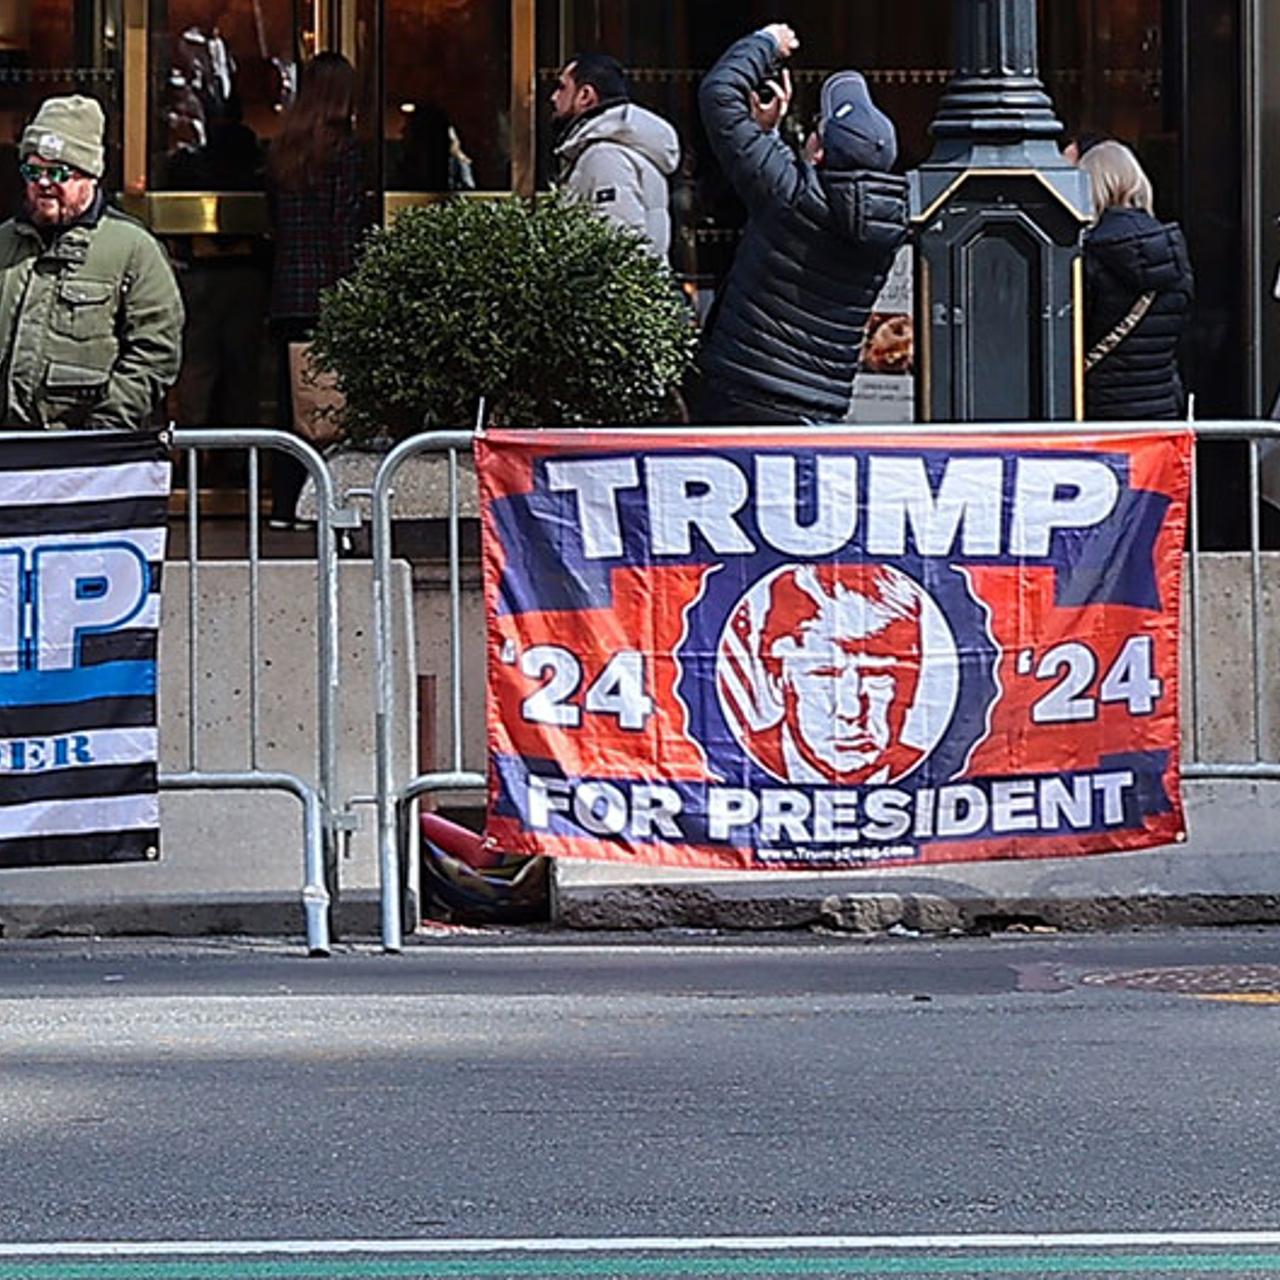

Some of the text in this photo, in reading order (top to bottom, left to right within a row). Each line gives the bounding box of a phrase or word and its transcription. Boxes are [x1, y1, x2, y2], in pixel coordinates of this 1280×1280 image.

[545, 454, 1120, 561] TRUMP
[526, 770, 1134, 843] FOR PRESIDENT
